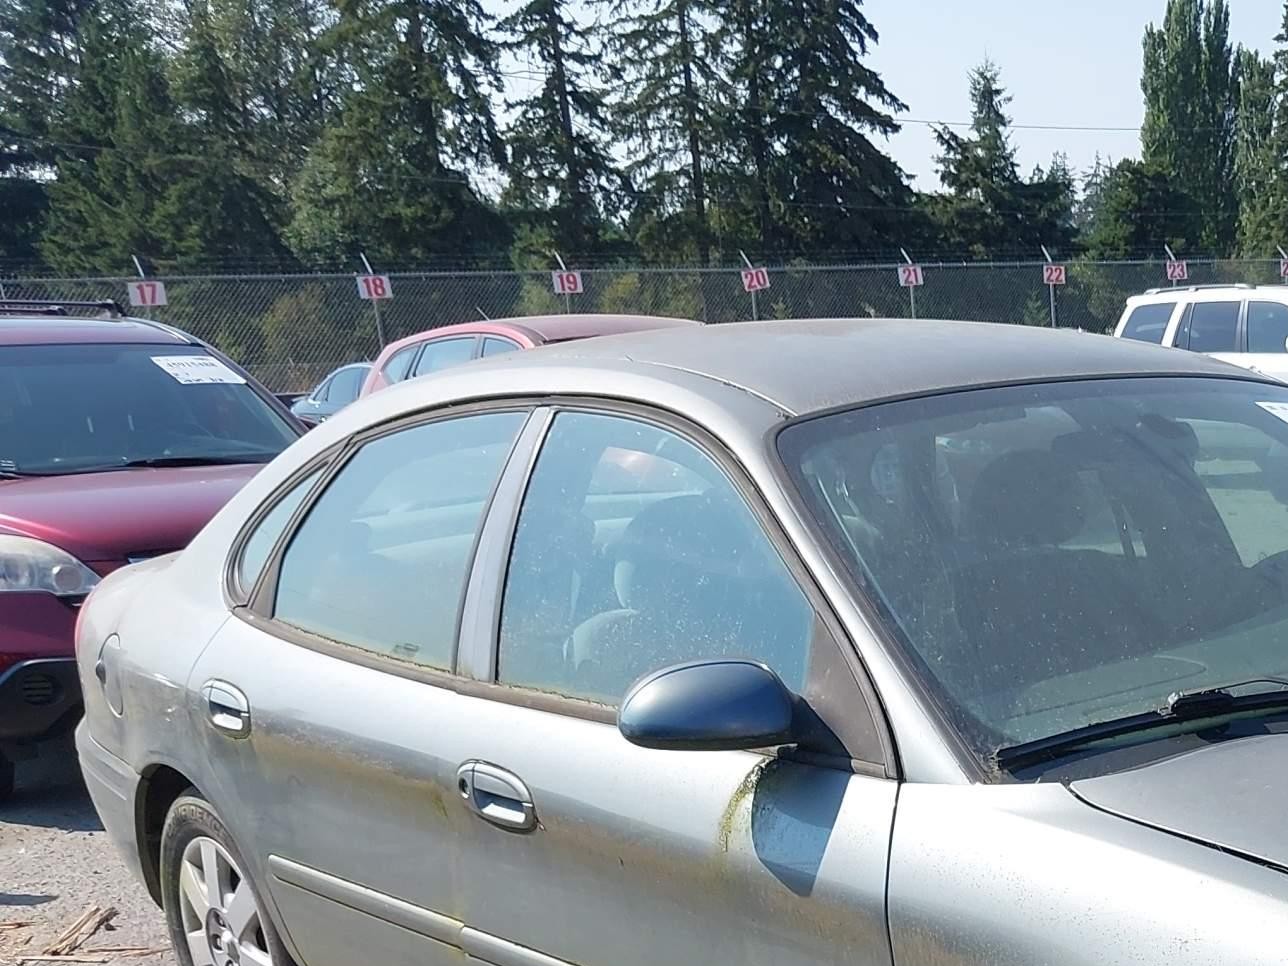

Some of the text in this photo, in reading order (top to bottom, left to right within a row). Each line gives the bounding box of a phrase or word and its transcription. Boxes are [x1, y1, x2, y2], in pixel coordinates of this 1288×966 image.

[744, 270, 767, 289] 20
[903, 268, 919, 285] 21
[1045, 267, 1063, 283] 22
[1168, 262, 1185, 279] 23
[363, 277, 386, 297] 18
[557, 273, 578, 292] 19
[136, 283, 157, 305] 17
